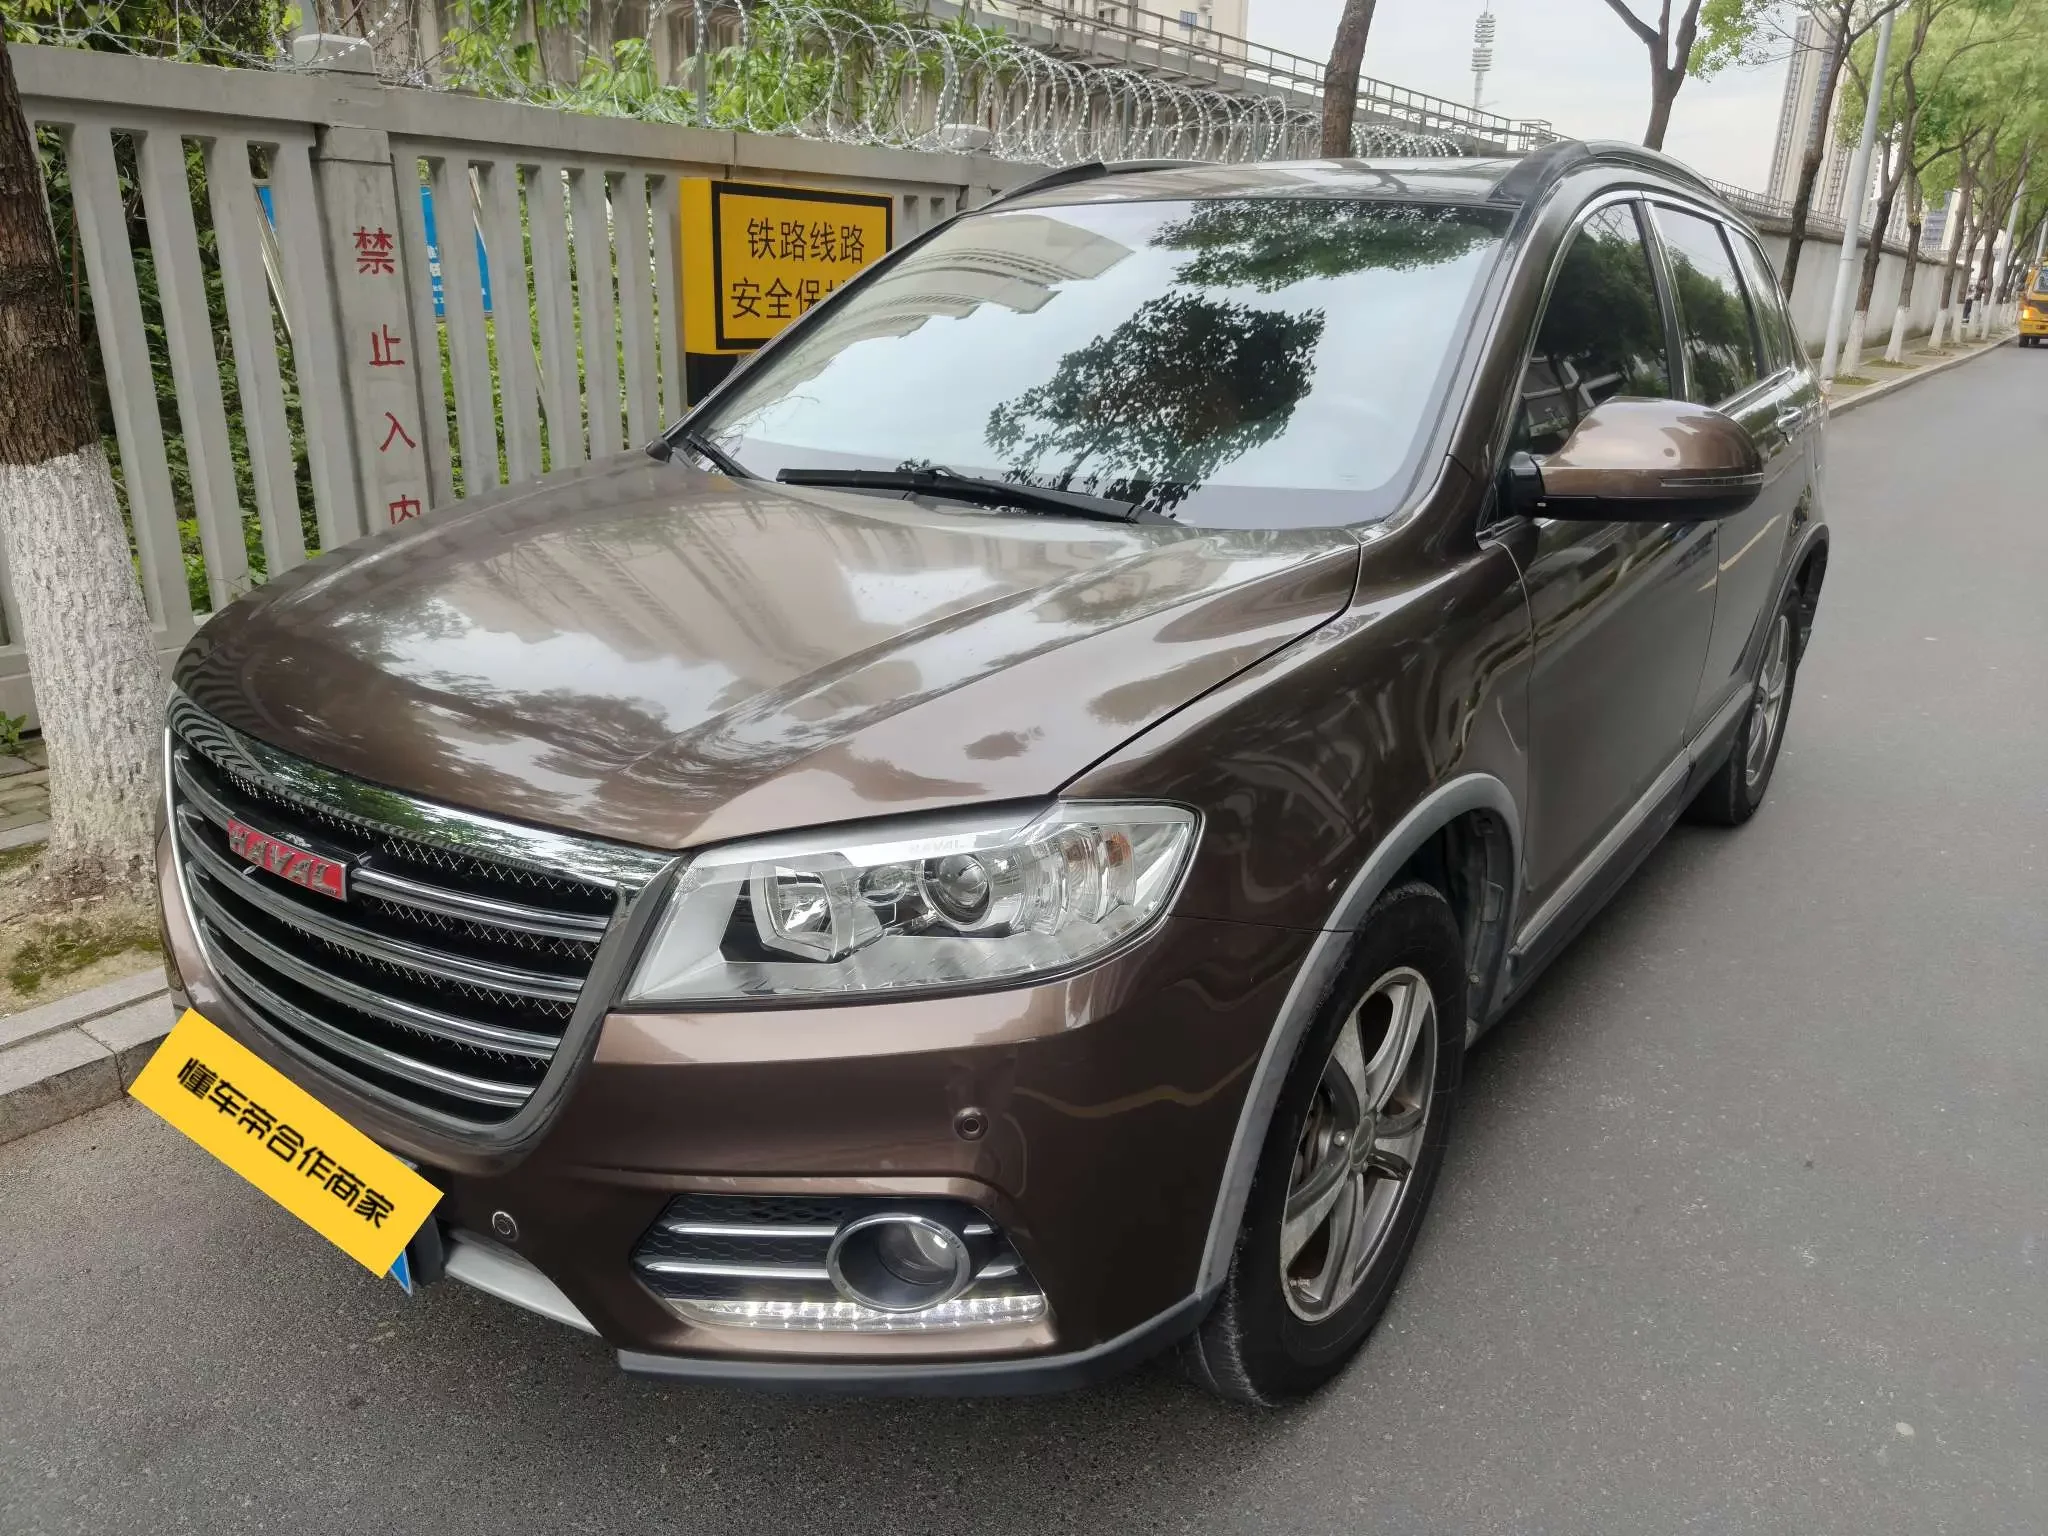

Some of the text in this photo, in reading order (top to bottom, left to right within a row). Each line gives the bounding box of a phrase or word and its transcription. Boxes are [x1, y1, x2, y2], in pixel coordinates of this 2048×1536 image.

[747, 217, 865, 264] 铁路线路
[730, 277, 848, 319] 安全保
[352, 226, 422, 524] 禁止入内
[229, 829, 337, 896] HAVAL
